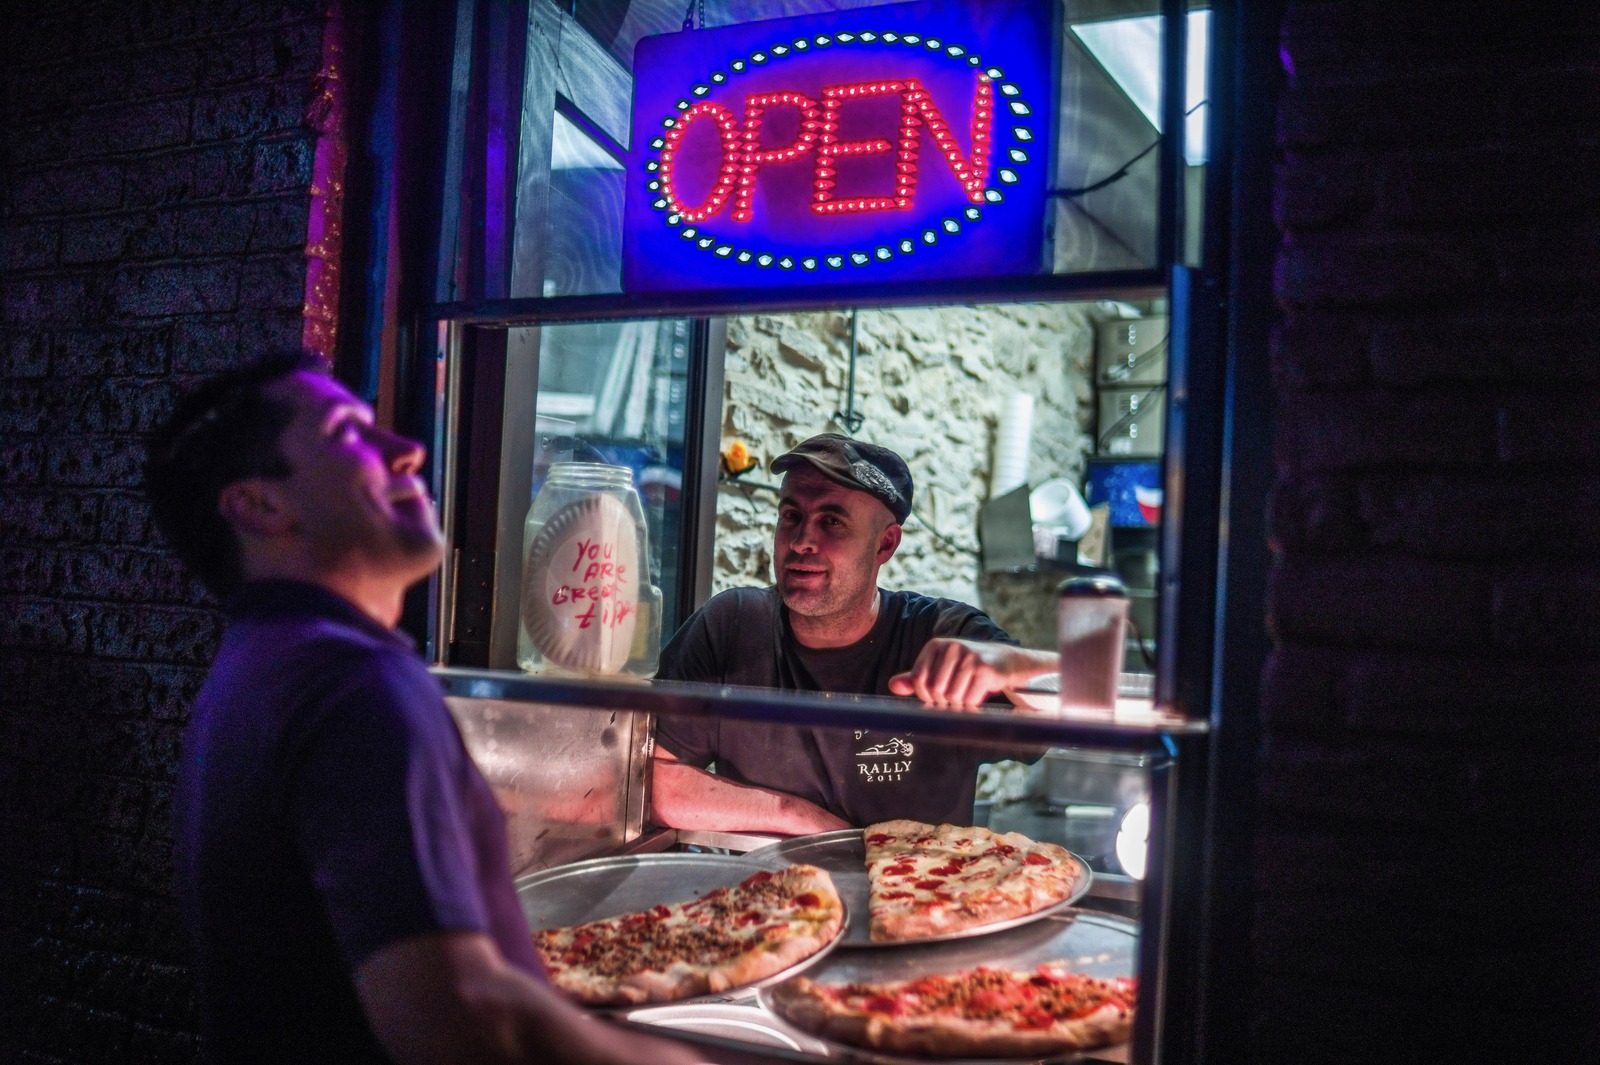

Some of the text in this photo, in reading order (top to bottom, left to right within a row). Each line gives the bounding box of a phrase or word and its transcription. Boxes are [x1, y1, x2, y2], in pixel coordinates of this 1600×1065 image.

[660, 72, 992, 222] OPEN
[857, 761, 912, 775] RALLY
[867, 774, 901, 782] 2011
